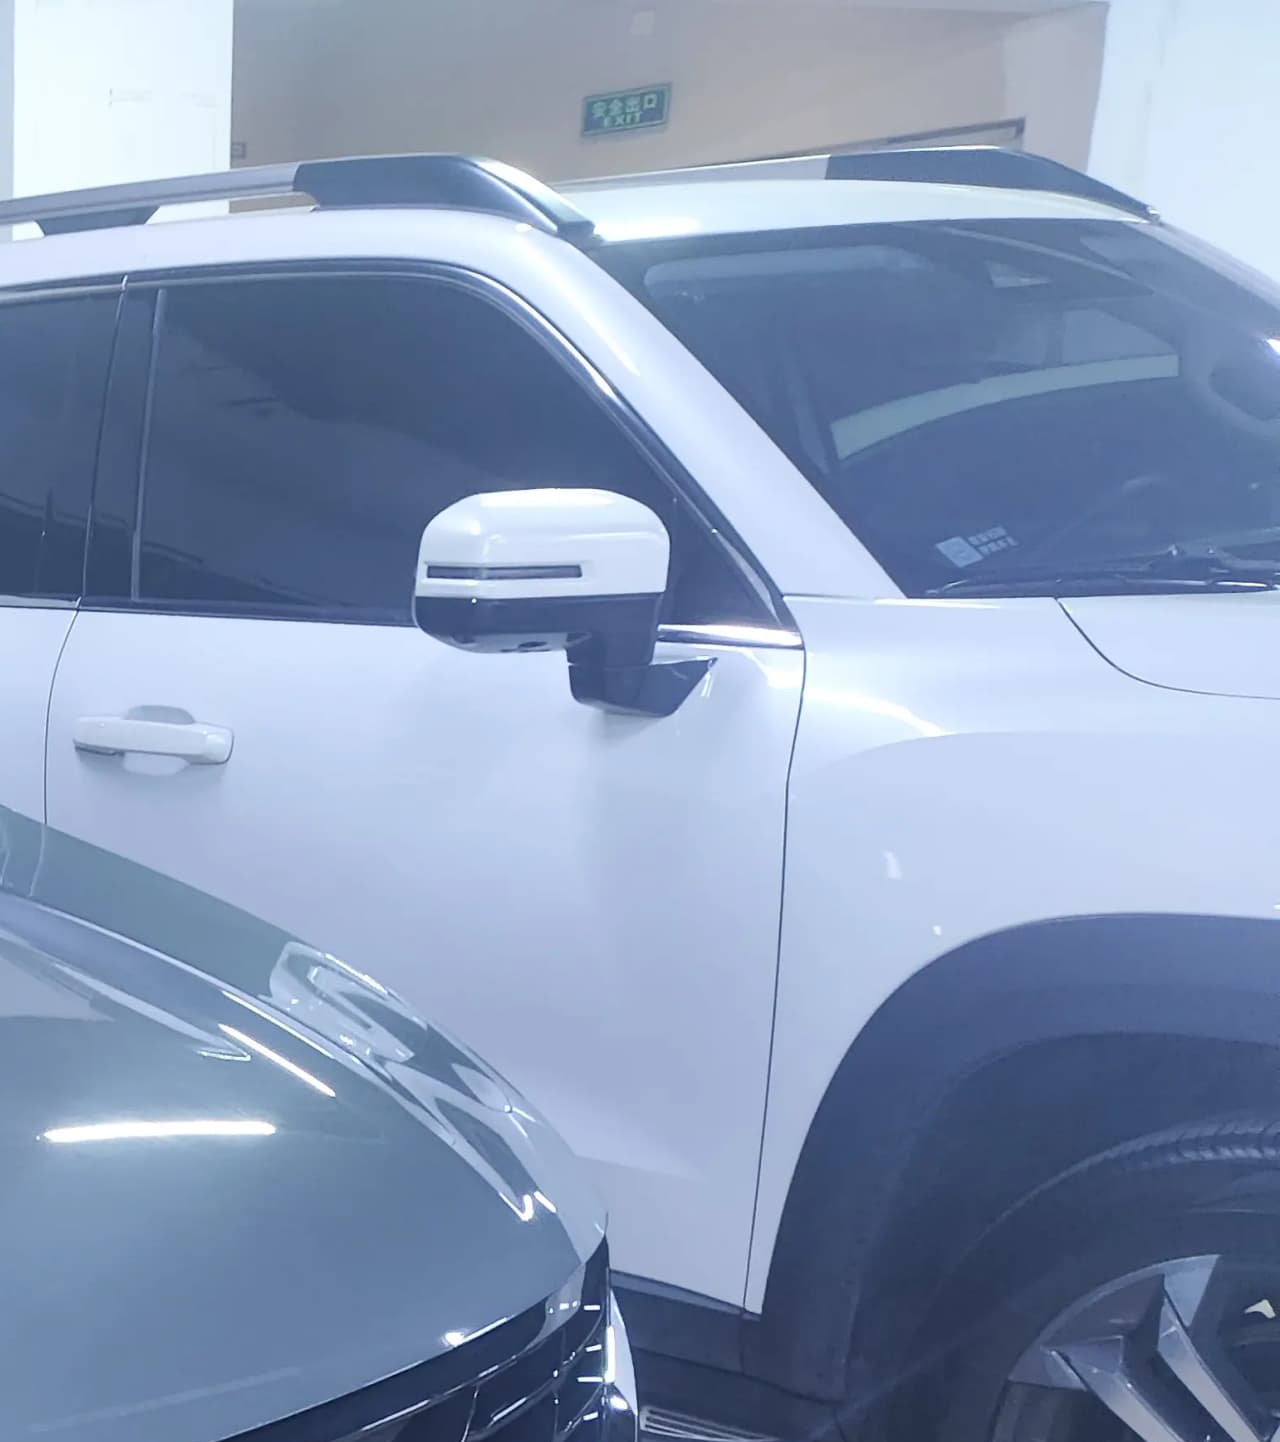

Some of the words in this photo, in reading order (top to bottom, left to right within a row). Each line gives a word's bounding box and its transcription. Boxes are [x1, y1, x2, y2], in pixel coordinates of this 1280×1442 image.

[591, 93, 658, 120] 安全出口
[603, 111, 643, 128] EXIT
